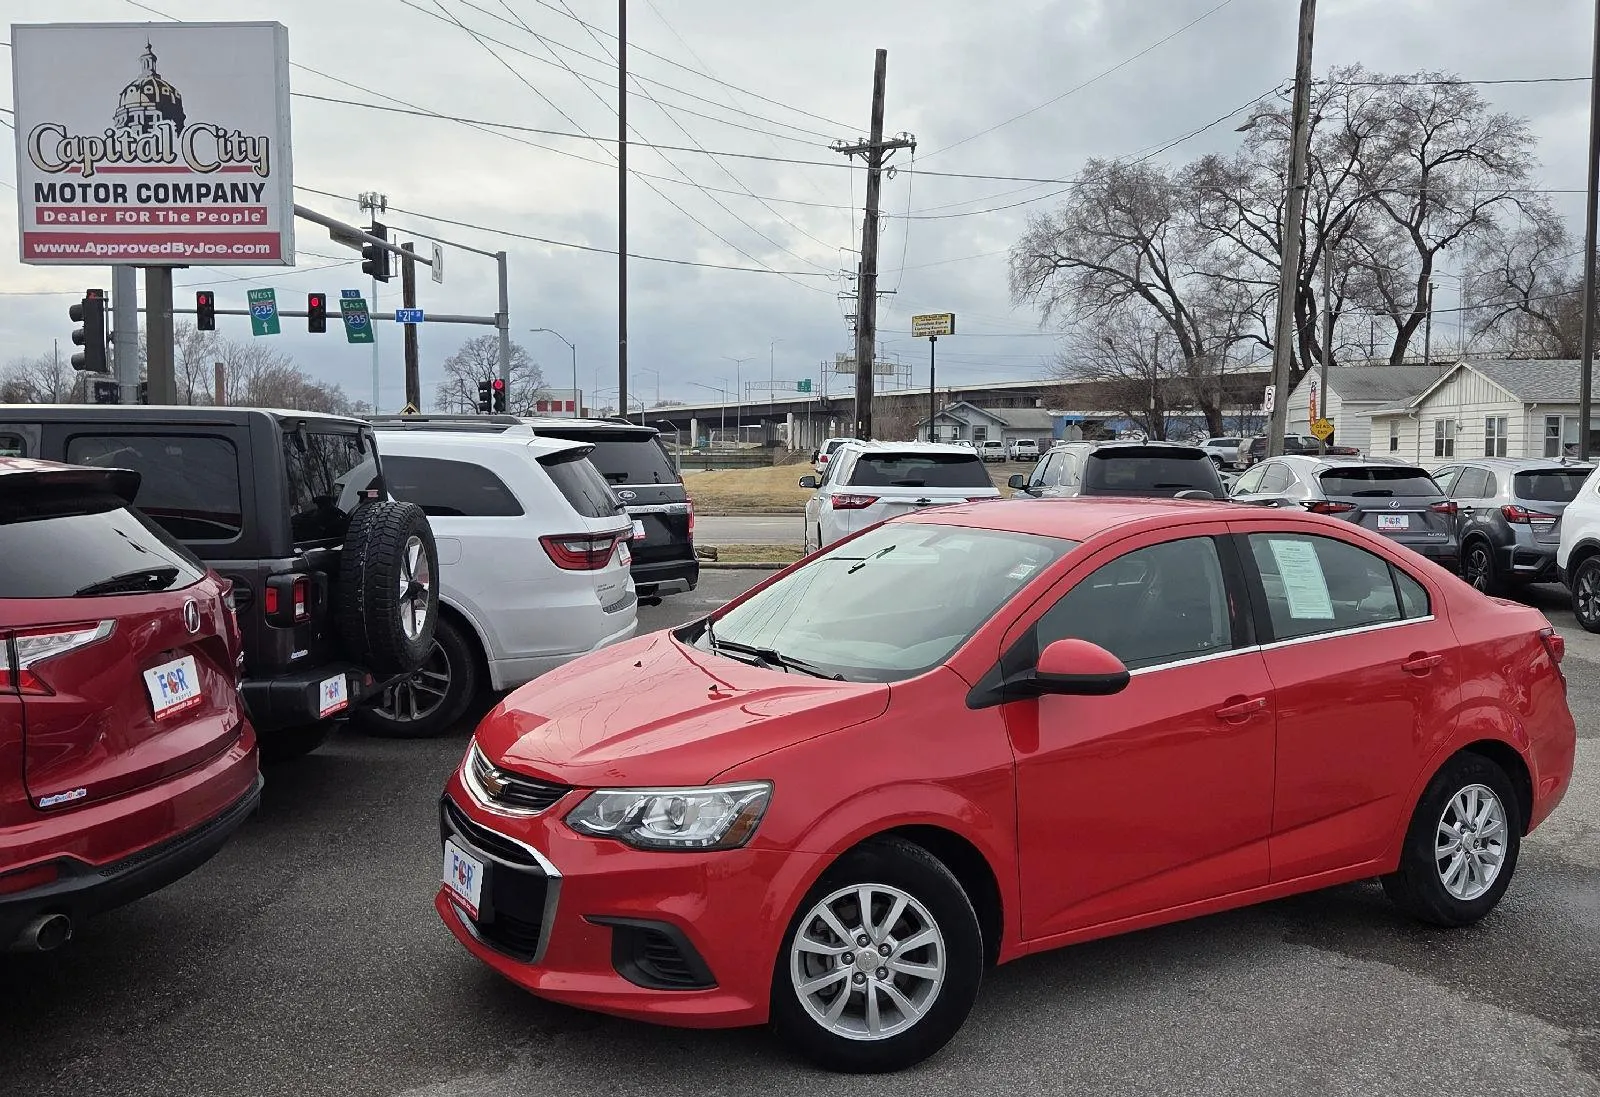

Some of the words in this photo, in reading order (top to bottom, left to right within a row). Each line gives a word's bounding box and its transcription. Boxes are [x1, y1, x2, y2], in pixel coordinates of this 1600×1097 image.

[28, 123, 177, 178] Capital
[181, 123, 270, 178] City
[35, 183, 128, 203] MOTOR
[136, 182, 266, 203] COMPANY
[43, 210, 108, 222] Dealer
[115, 211, 150, 223] FOR
[156, 210, 190, 223] The
[196, 210, 261, 224] People
[33, 242, 270, 256] www.ApprovedByJoe.com
[254, 305, 273, 315] 235
[347, 315, 366, 324] 235
